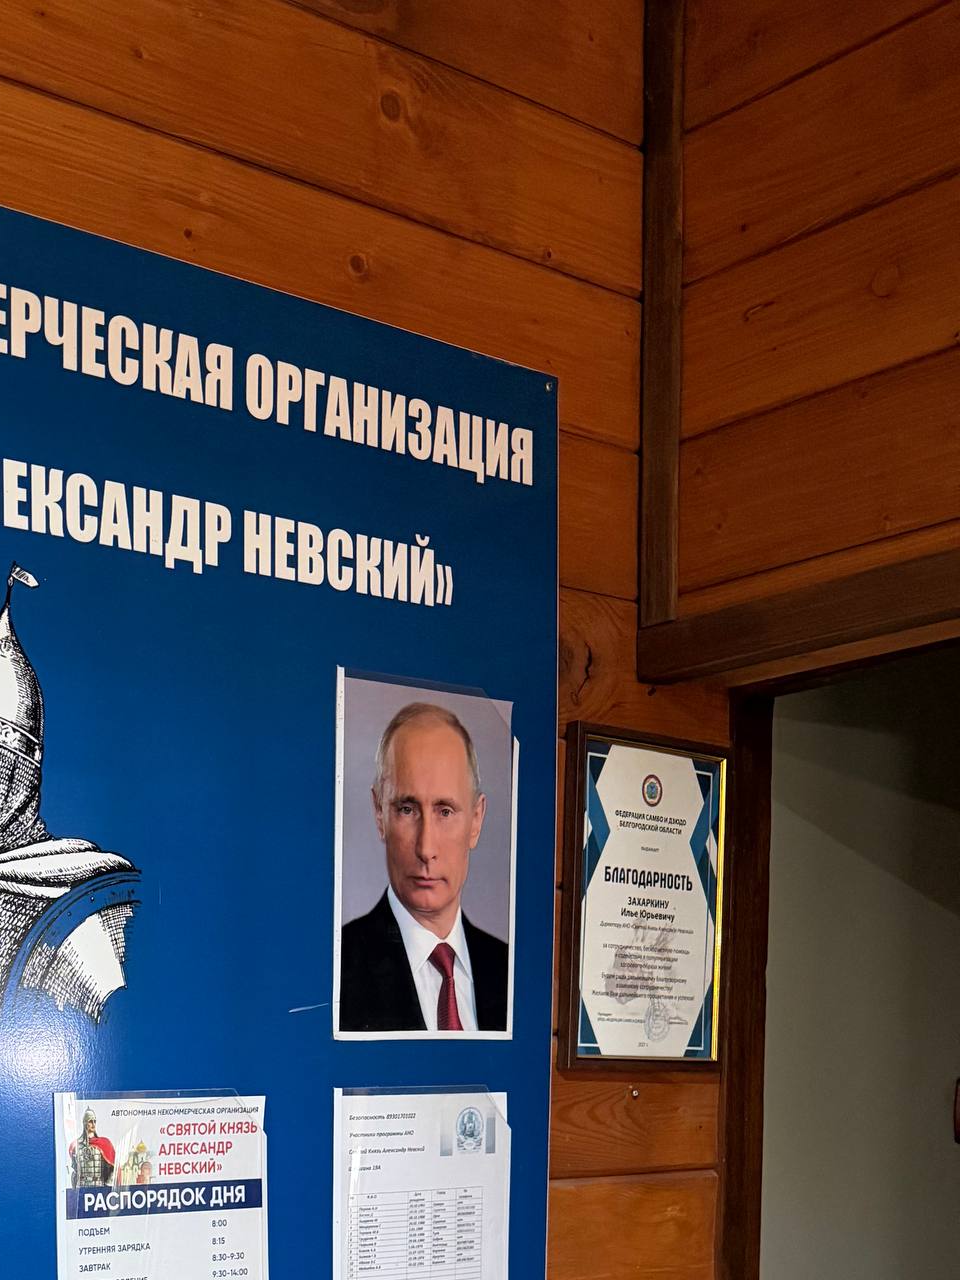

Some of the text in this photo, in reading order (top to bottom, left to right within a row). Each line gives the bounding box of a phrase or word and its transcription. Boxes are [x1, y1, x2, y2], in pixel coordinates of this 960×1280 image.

[246, 353, 534, 486] ОРГАНИЗАЦИЯ
[243, 510, 454, 607] НЕВСКИЙ»
[615, 809, 645, 820] ФЕДЕРАЦИЯ
[668, 818, 687, 826] ДЗЮДО
[619, 820, 682, 835] БЕЛГОРОДСКОЙ ОБЛАСТИ
[605, 866, 693, 891] БЛАГОДАРНОСТЬ
[628, 896, 670, 910] ЗАХАРКИНУ
[621, 907, 675, 923] Илье Юрьевичу
[111, 1106, 259, 1117] АВТОНОМНАЯ НЕКОММЕРЧЕСКАЯ ОРГАНИЗАЦИЯ
[159, 1119, 258, 1136] «СВЯТОЙ КНЯЗЬ
[158, 1140, 233, 1156] АЛЕКСАНДР
[158, 1158, 222, 1176] НЕВСКИЙ»
[84, 1185, 246, 1212] РАСПОРЯДОК ДНЯ
[78, 1219, 228, 1237] ПОДЪЕМ 8:00
[78, 1237, 226, 1255] УТРЕННЯЯ ЗАРЯДКА 8:15
[79, 1252, 245, 1273] ЗАВТРАК 8:30-9:30
[212, 1267, 248, 1278] 9:30-14:00
